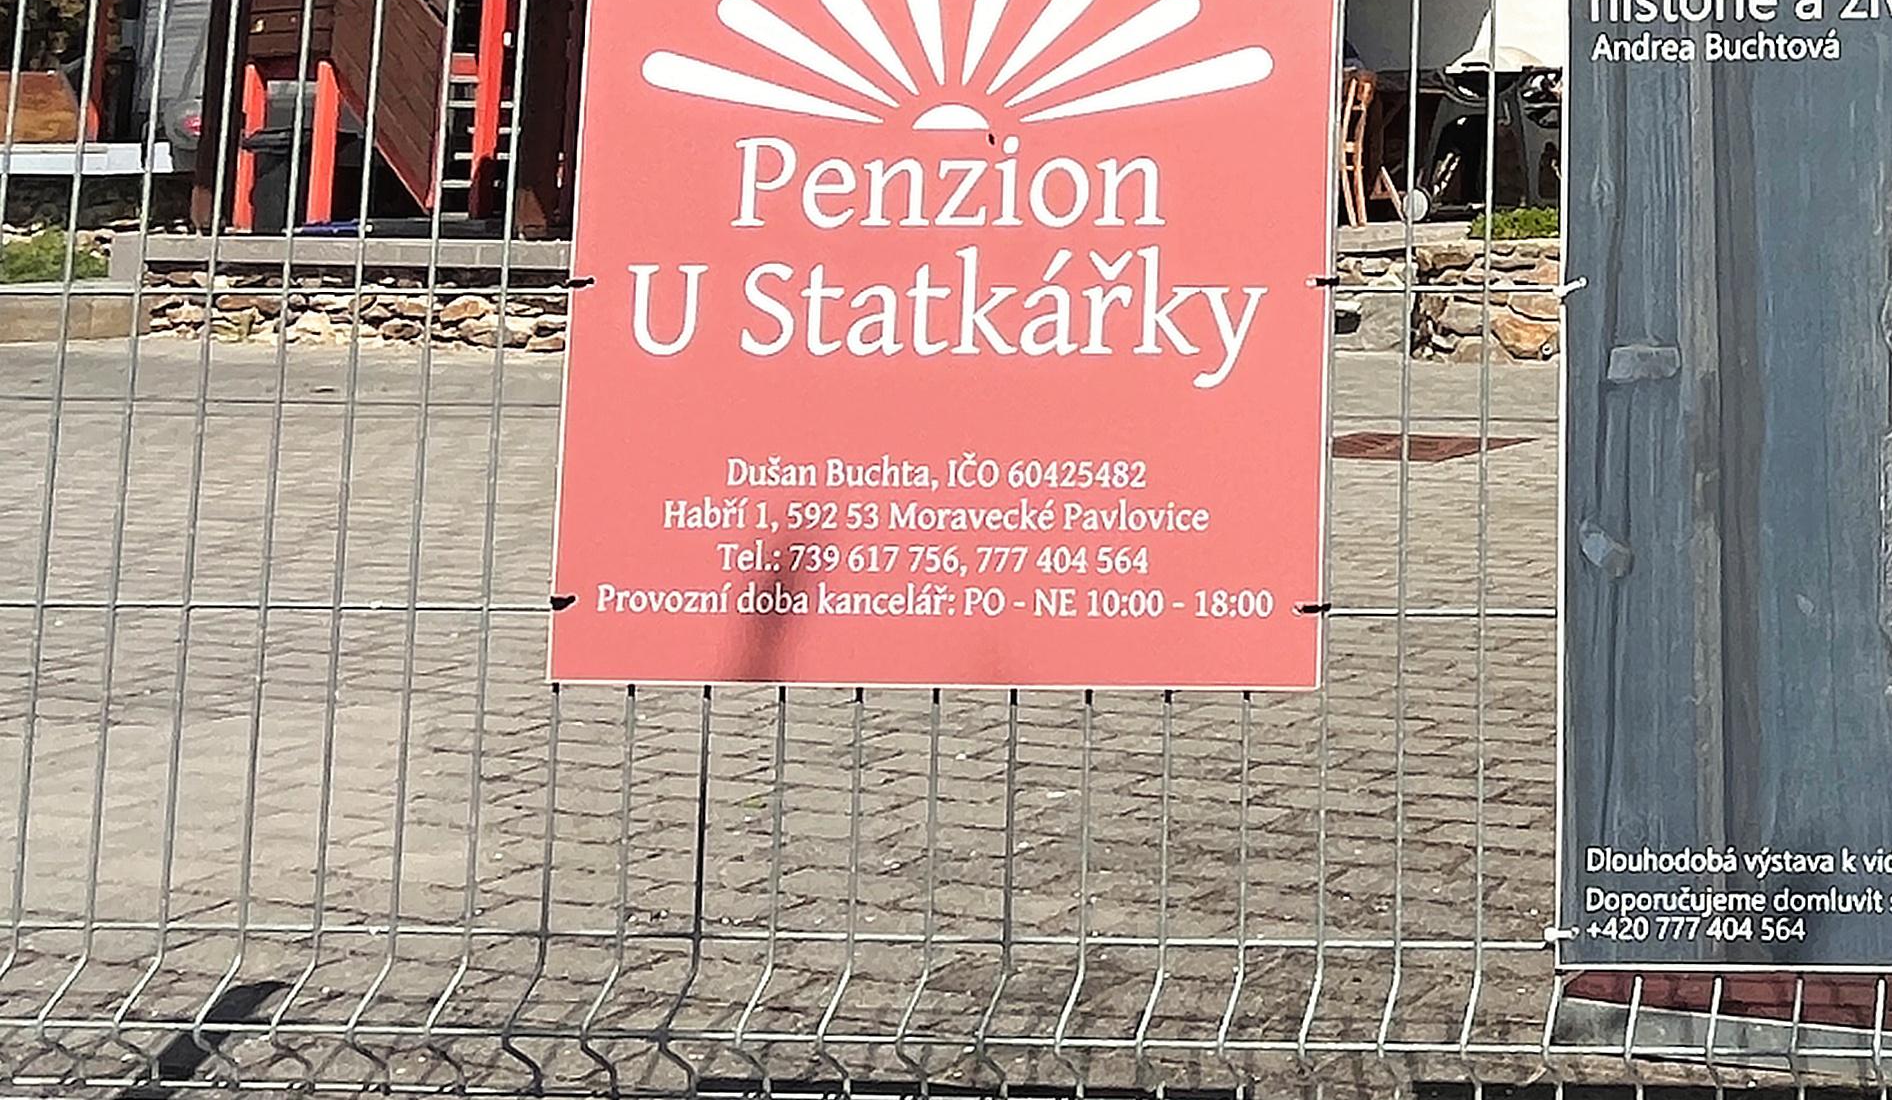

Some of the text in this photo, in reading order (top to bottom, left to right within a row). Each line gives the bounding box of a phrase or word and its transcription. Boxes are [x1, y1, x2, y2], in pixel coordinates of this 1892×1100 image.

[1591, 28, 1840, 62] Andrea Buchtová
[731, 136, 1165, 229] Penzion
[628, 245, 1269, 388] U Statkářky
[727, 452, 1148, 490] Dušan Buchta, IČO 60425482
[663, 497, 1210, 532] Habří 1, 592 53 Moravecké Pavlovice
[716, 540, 1149, 578] Tel.: 739 617 756, 777 404 564
[596, 583, 732, 613] Provozní
[737, 583, 809, 614] doba
[817, 583, 955, 616] kancelář:
[964, 587, 1005, 617] PO
[1033, 588, 1077, 617] NE
[1087, 589, 1164, 617] 10:00
[1194, 590, 1274, 617] 18:00
[1586, 847, 1738, 873] Dlouhodobá
[1743, 849, 1833, 879] výstava
[1842, 847, 1855, 873] k
[1586, 886, 1765, 917] Doporučujeme
[1773, 887, 1884, 912] domluvit
[1586, 917, 1806, 941] +420 777 404 564
